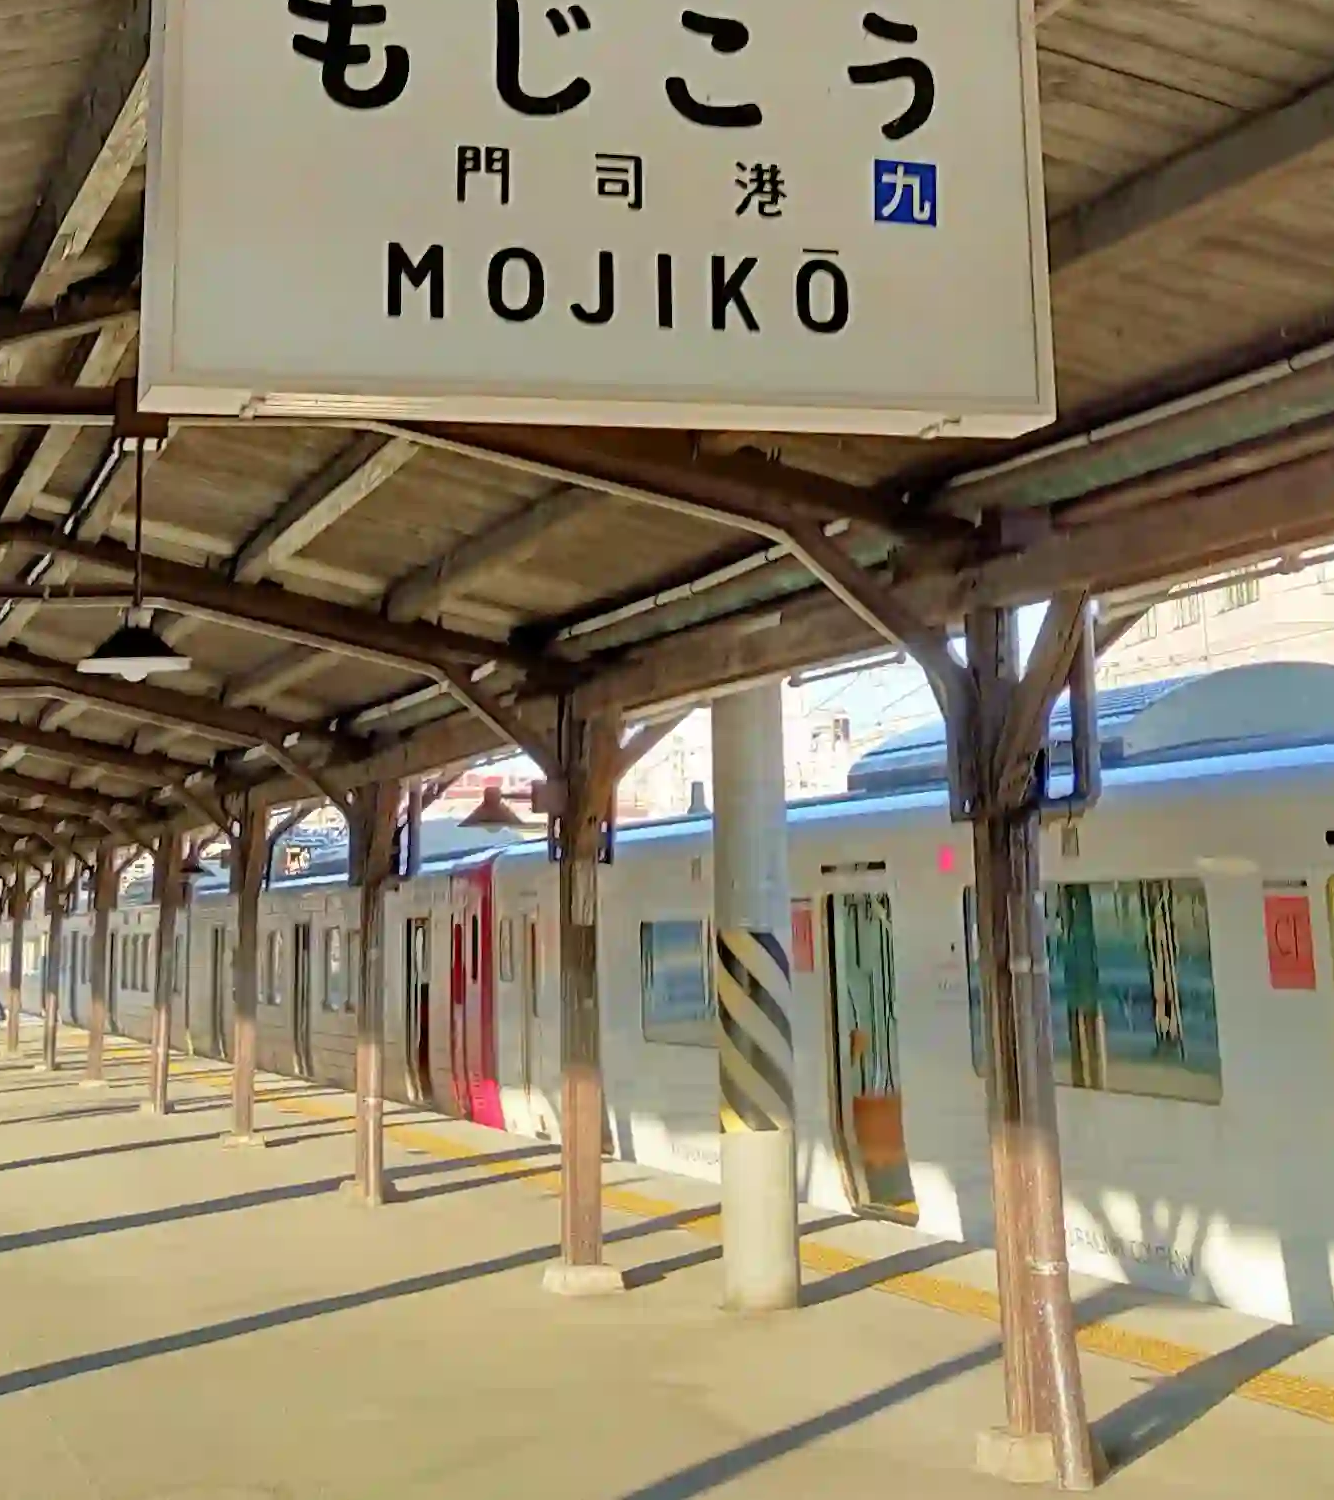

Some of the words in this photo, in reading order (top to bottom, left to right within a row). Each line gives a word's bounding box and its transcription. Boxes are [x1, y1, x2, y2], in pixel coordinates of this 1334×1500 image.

[456, 145, 788, 218] 門司港
[877, 162, 934, 224] 九
[387, 241, 850, 334] MOJIKŌ
